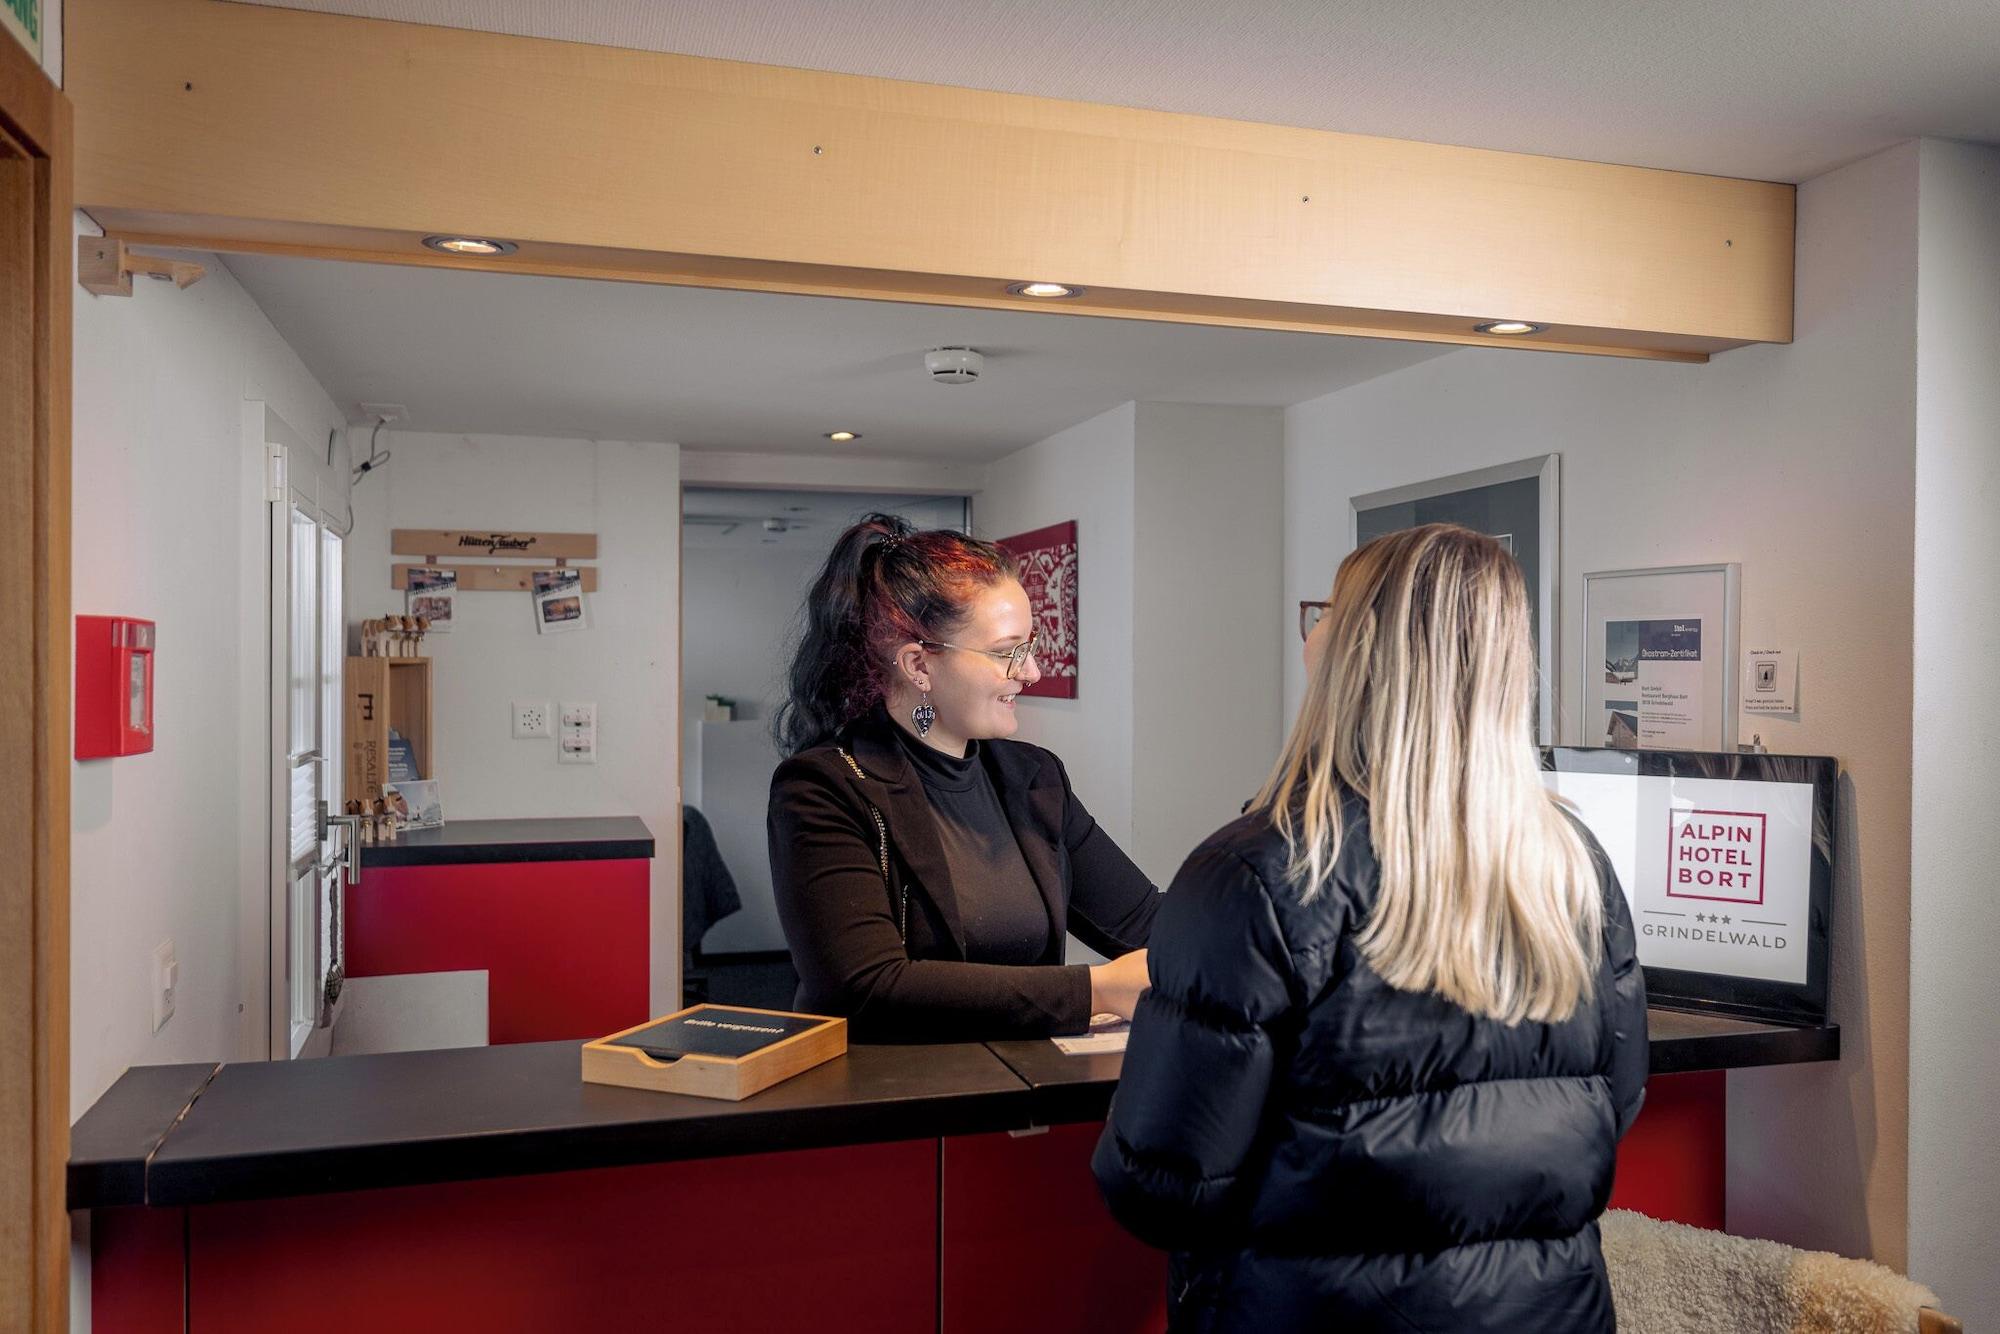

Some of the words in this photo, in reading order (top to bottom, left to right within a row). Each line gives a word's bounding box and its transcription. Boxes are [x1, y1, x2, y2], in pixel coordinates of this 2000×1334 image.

[1680, 823, 1752, 843] ALPIN
[1680, 846, 1752, 866] HOTEL
[1679, 868, 1752, 888] BORT
[1642, 924, 1788, 949] GRINDELWALD
